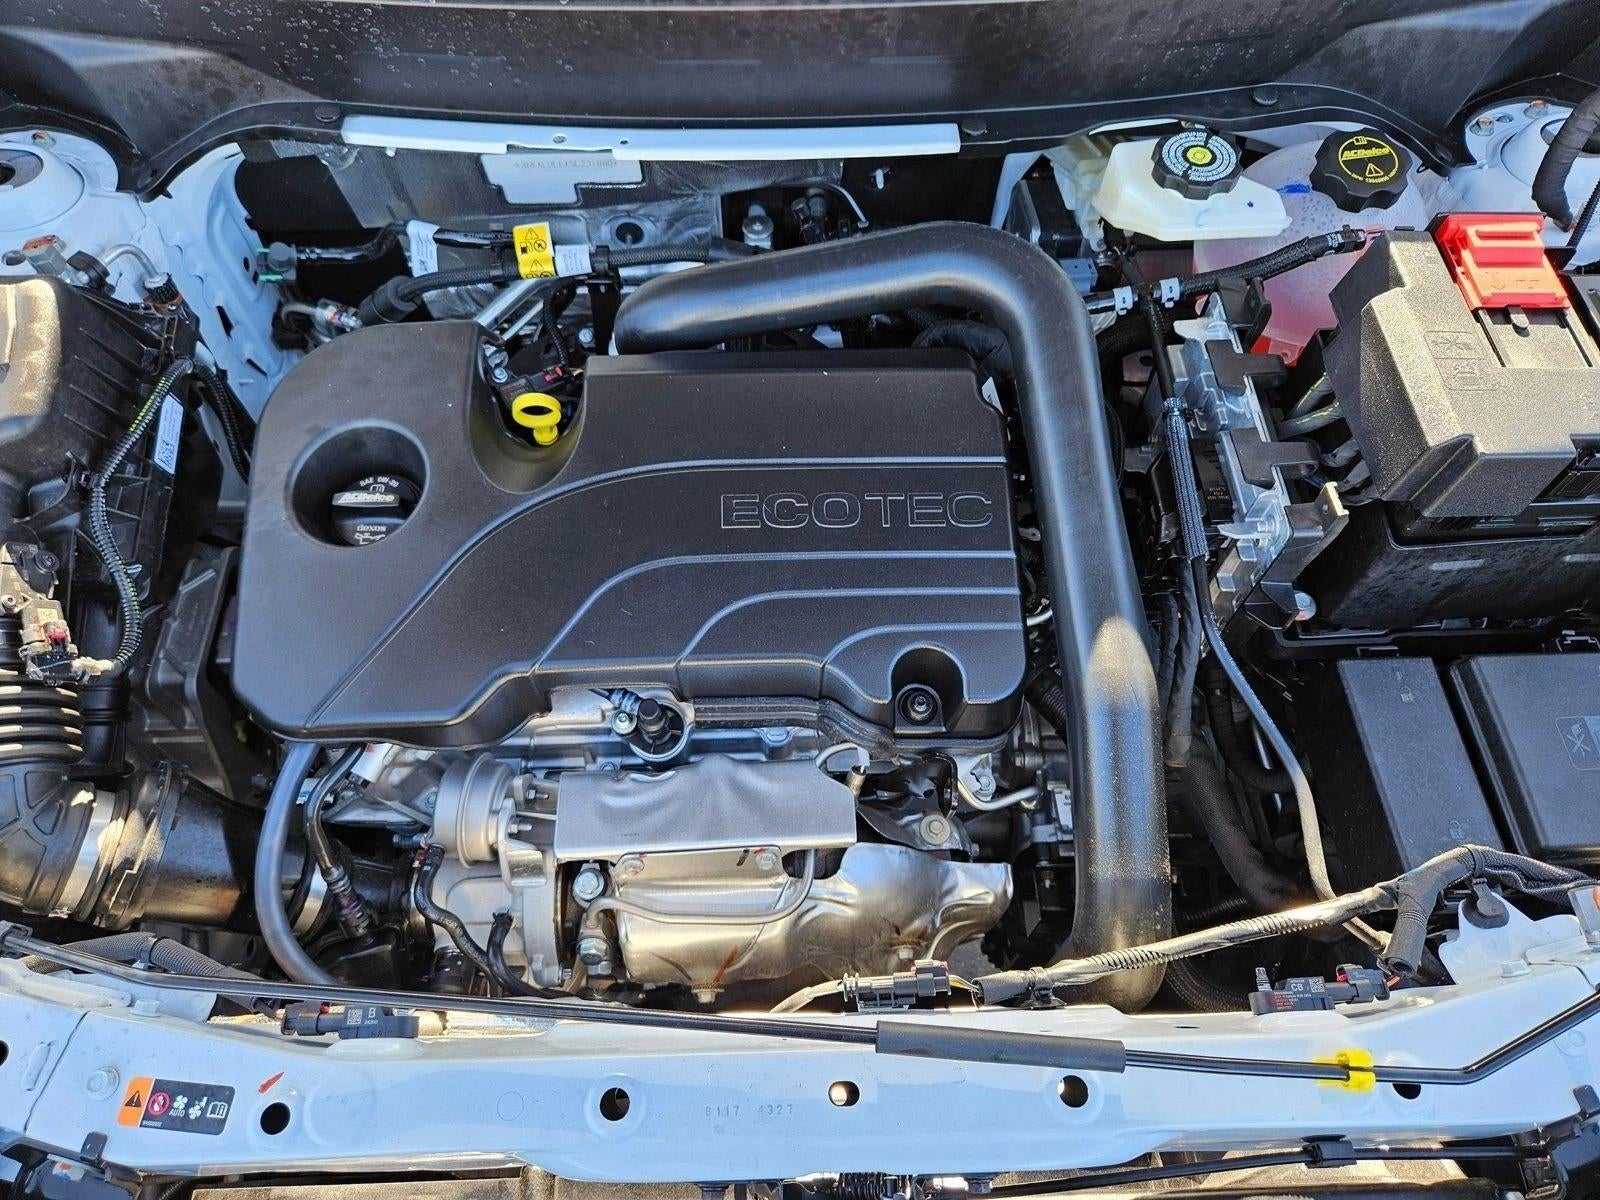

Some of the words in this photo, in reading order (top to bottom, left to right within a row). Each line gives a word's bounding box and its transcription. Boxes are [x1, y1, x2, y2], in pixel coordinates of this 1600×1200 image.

[1342, 147, 1390, 159] ACDelco
[360, 477, 374, 487] SAE
[721, 491, 993, 528] ECOTEC
[1291, 983, 1303, 992] CB
[368, 1007, 376, 1018] B
[169, 1108, 185, 1117] AUTO
